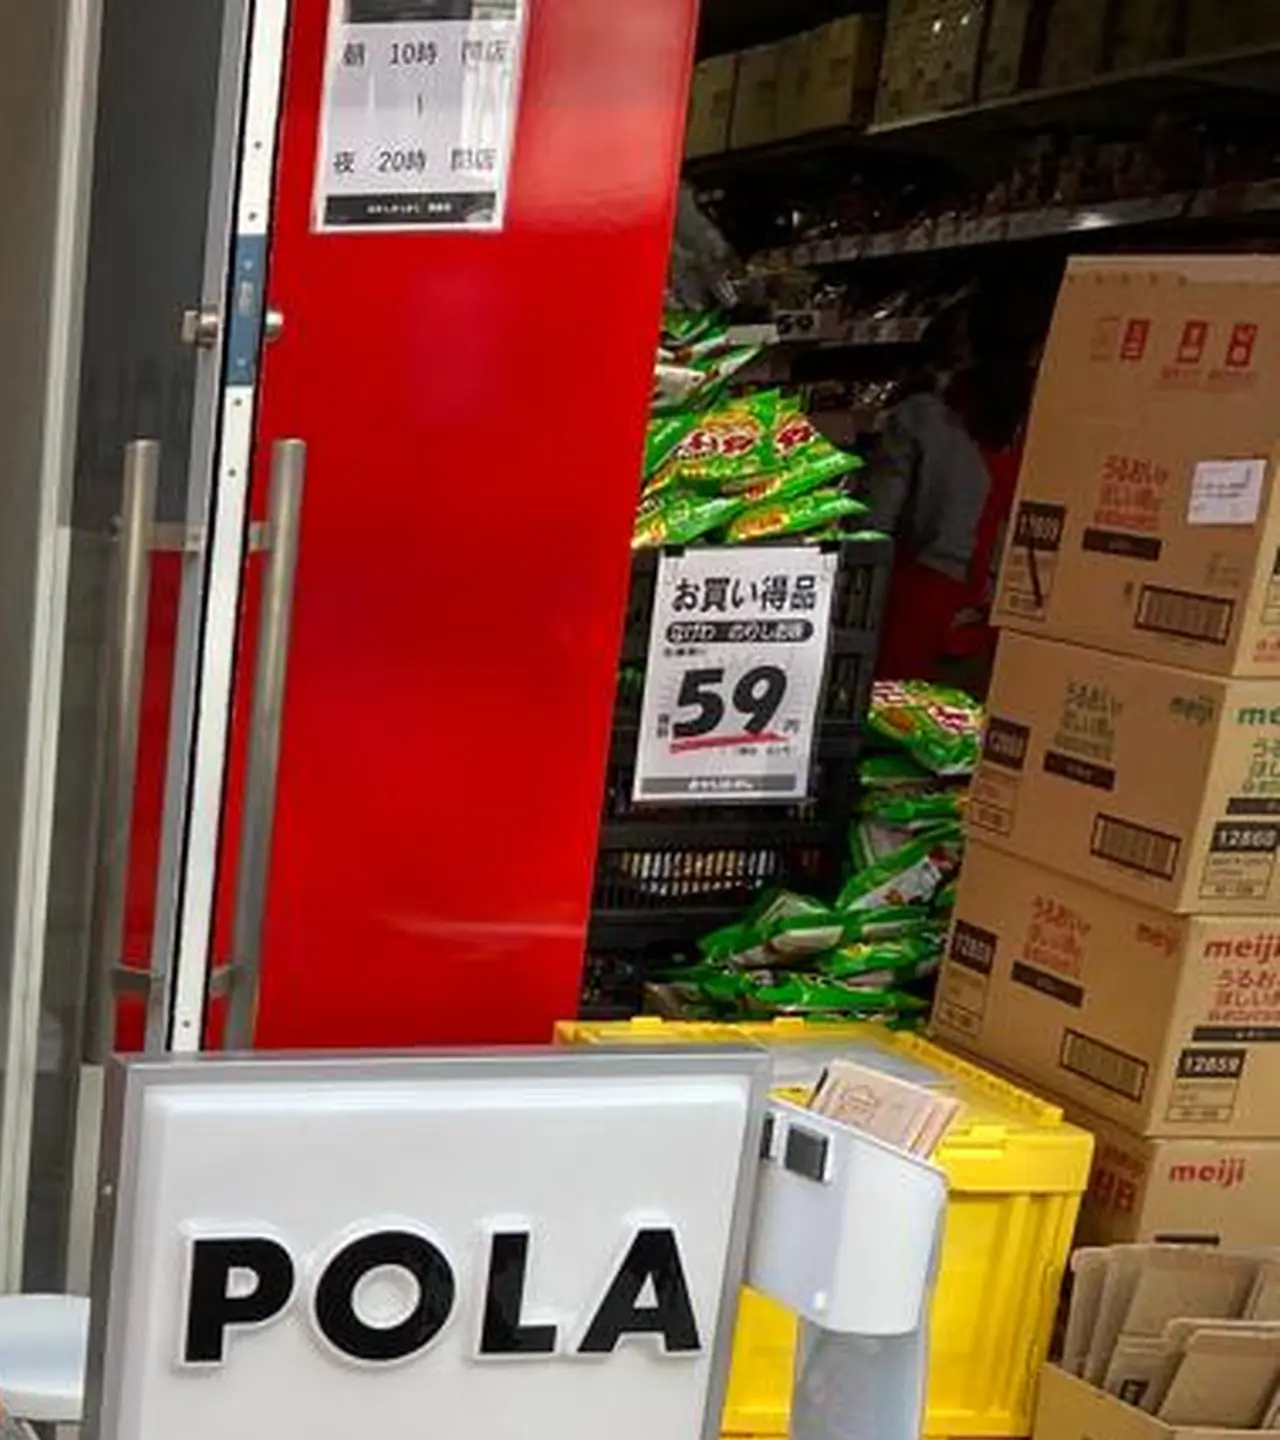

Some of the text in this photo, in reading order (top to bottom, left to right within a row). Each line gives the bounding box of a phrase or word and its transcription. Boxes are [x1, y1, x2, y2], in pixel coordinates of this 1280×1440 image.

[671, 574, 817, 613] お買い得品
[672, 665, 788, 739] 59
[1168, 1158, 1246, 1189] meiji
[184, 1229, 701, 1363] POLA
